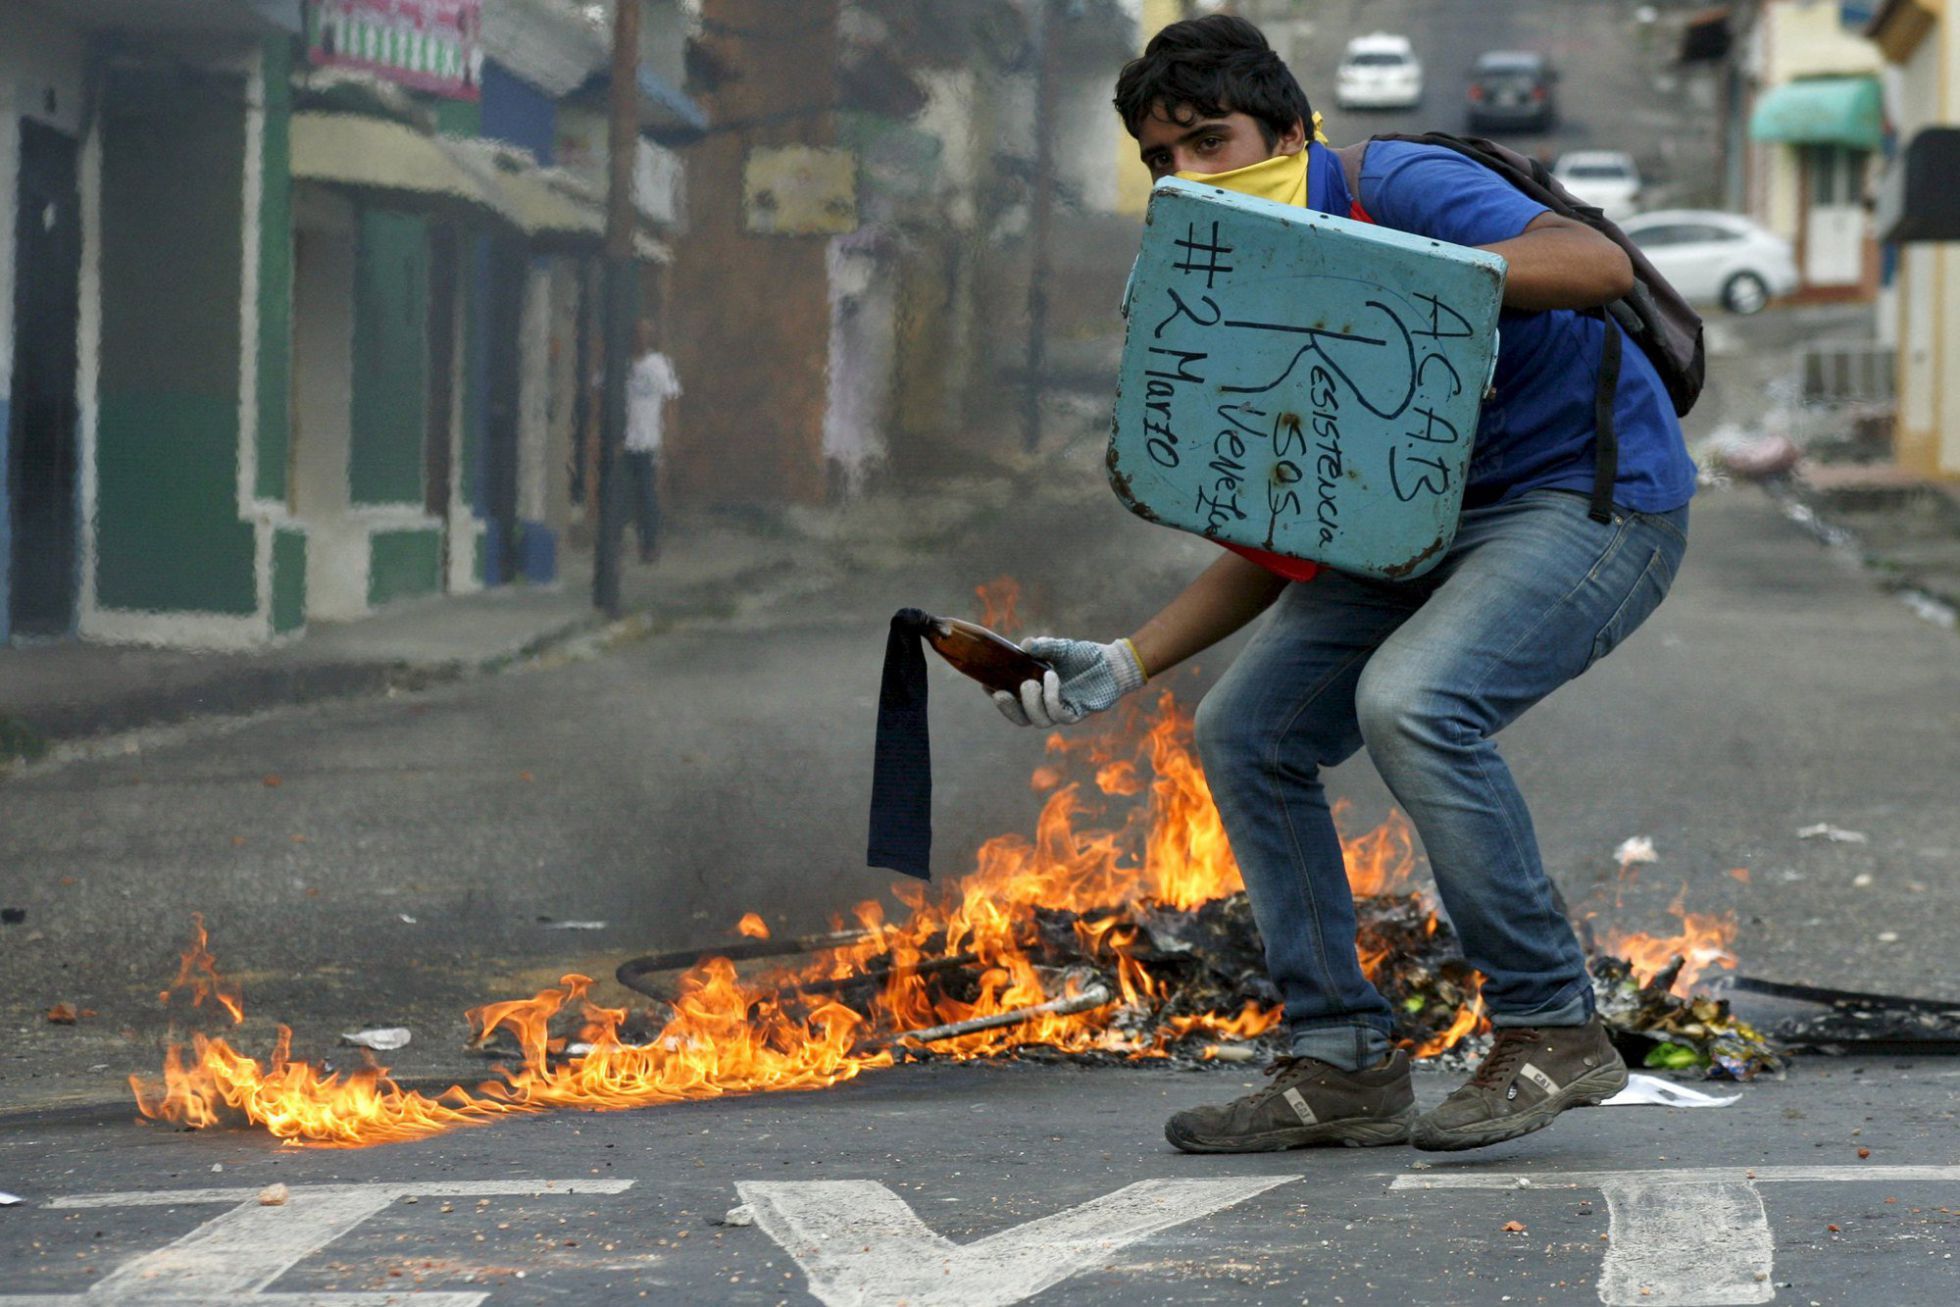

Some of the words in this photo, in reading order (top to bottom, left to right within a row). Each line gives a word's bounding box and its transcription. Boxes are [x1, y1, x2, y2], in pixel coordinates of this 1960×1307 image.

[1267, 412, 1307, 516] SOS
[1533, 1073, 1551, 1089] CAT
[1294, 1101, 1311, 1119] CAT
